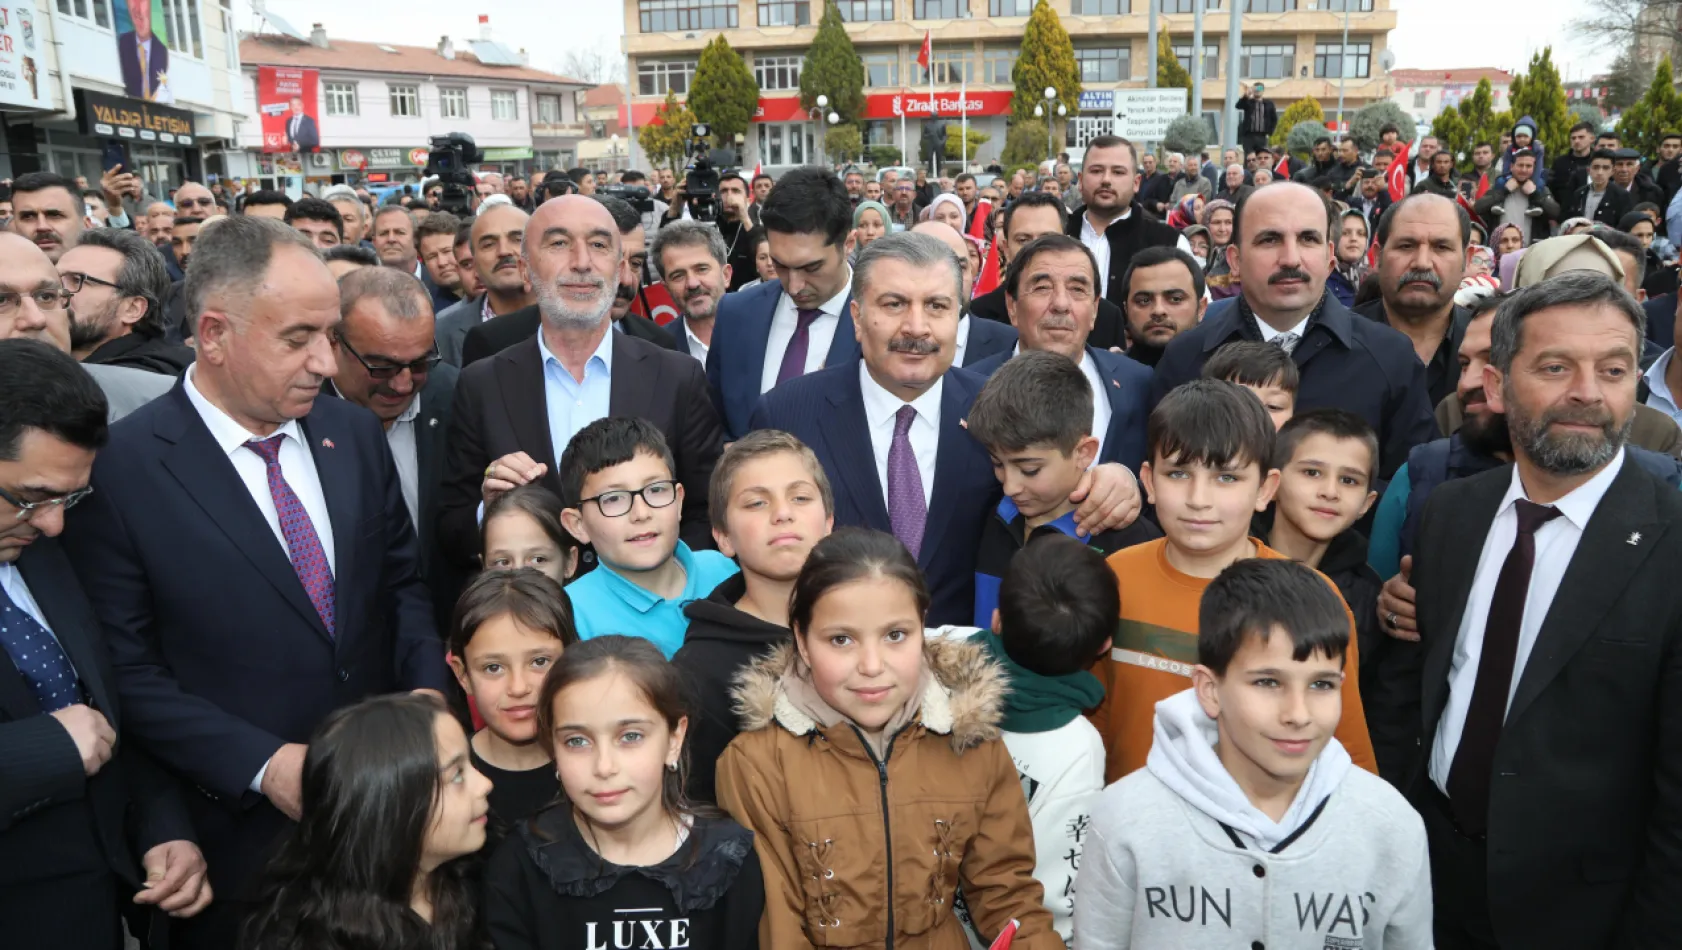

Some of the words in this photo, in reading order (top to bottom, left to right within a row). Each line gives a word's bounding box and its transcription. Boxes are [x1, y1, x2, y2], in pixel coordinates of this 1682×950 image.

[92, 103, 142, 127] YALDIR
[1145, 884, 1232, 929] RUN
[585, 917, 690, 950] LUXE
